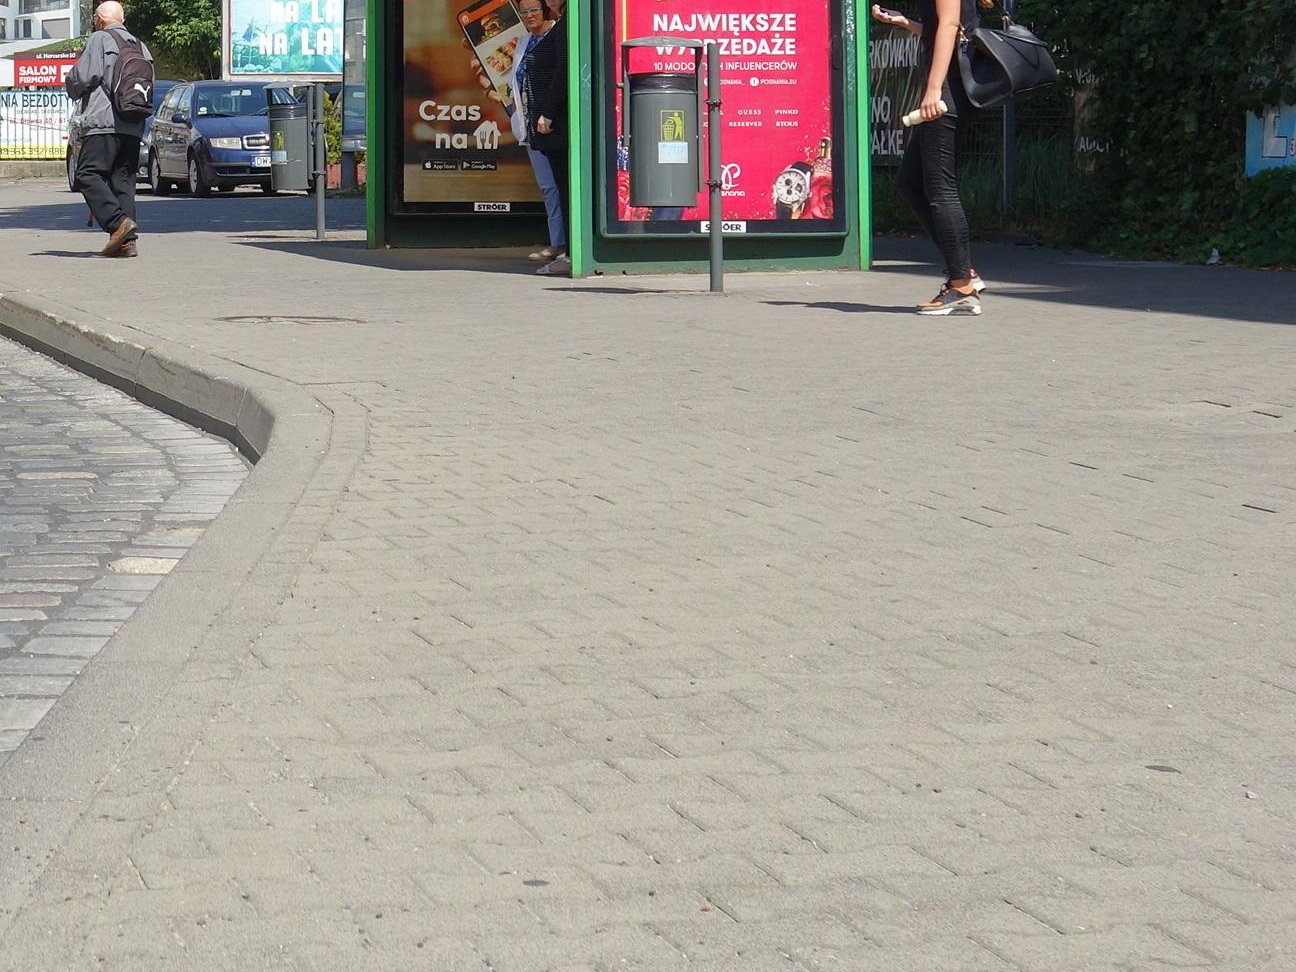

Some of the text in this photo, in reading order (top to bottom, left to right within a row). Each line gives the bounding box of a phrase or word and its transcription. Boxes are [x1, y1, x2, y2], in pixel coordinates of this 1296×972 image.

[270, 0, 299, 23] NA
[653, 13, 797, 36] NAJWIĘKSZE
[258, 32, 288, 55] NA
[19, 65, 57, 75] SALON
[653, 61, 663, 71] 10
[725, 59, 798, 71] INFLUENCERÓW
[19, 75, 57, 84] FIRMOWY
[419, 99, 482, 122] Czas
[435, 132, 468, 149] na
